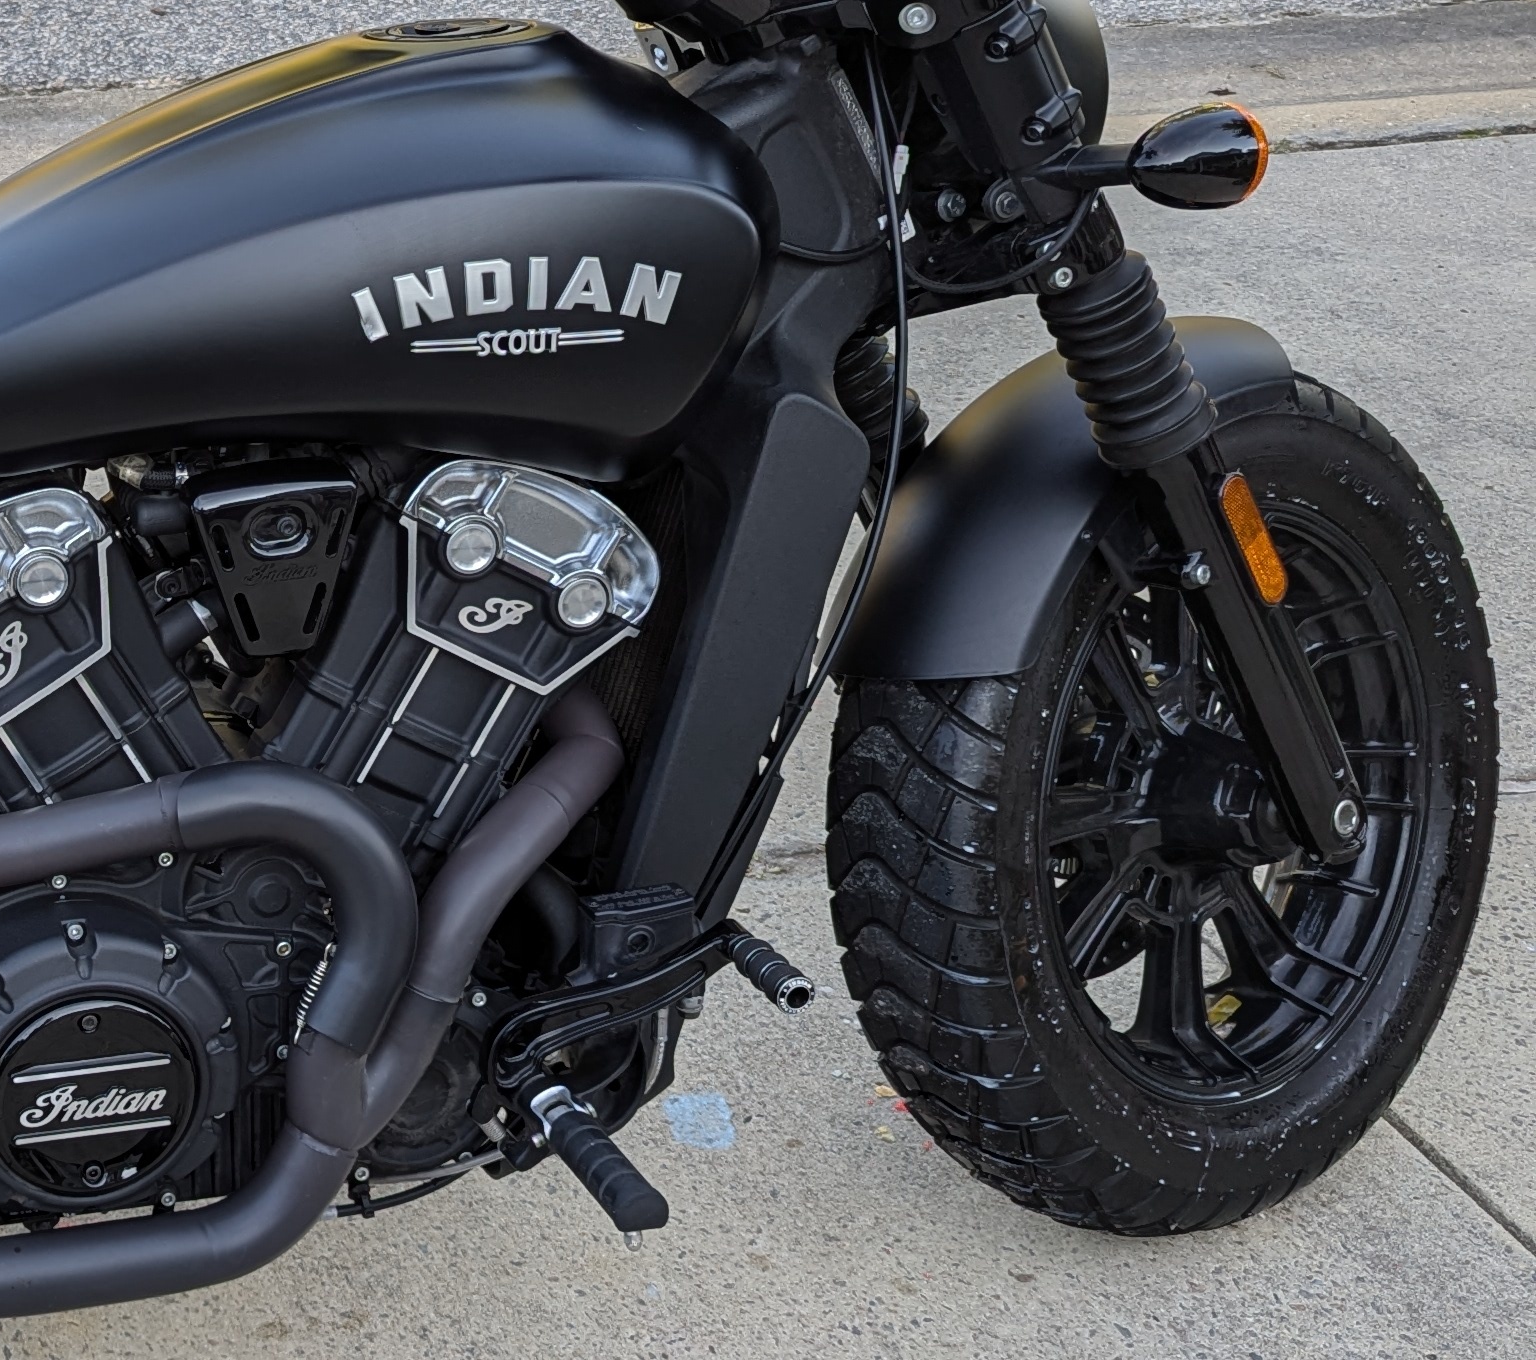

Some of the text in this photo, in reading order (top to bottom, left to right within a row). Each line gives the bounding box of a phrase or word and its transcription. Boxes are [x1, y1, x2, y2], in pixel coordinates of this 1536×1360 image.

[351, 256, 682, 342] INDIAN
[476, 326, 562, 357] SCOUT
[19, 1084, 168, 1128] Indian
